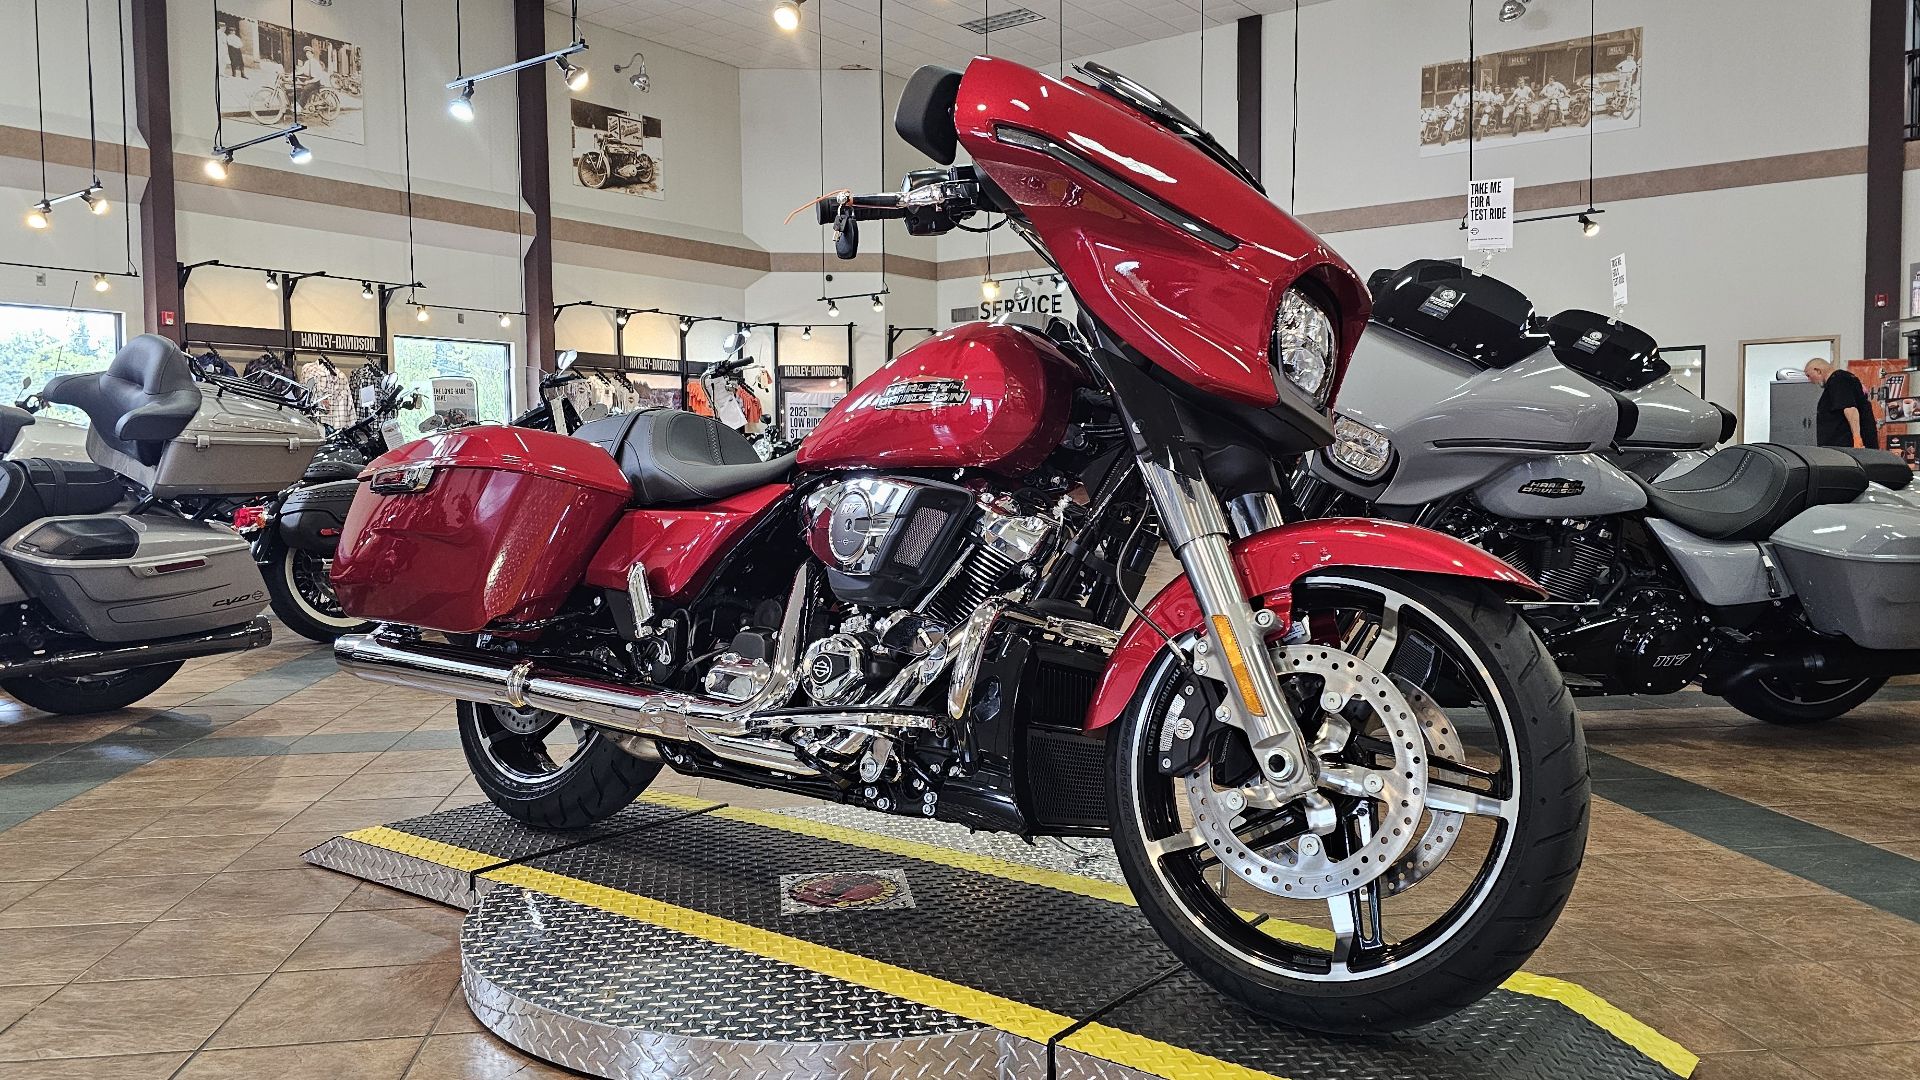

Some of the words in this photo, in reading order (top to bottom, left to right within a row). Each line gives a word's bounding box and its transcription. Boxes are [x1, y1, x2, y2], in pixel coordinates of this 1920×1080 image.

[1470, 182, 1488, 196] TAKE
[1490, 181, 1501, 194] ME
[1470, 196, 1484, 209] FOR
[1485, 195, 1491, 208] A
[1470, 208, 1488, 221] TEST
[1489, 206, 1507, 220] RIDE
[980, 293, 1062, 320] SERVICE
[300, 332, 376, 352] HARLEY-DAVIDSON
[629, 356, 679, 372] HARLEY-DAVIDSON
[784, 365, 843, 377] HARLEY-DAVIDSON
[876, 392, 967, 406] DAVIDSON
[789, 406, 808, 417] 2025
[790, 417, 805, 428] LOW
[790, 428, 799, 439] ST
[212, 594, 251, 607] CVO
[1652, 653, 1692, 668] 117
